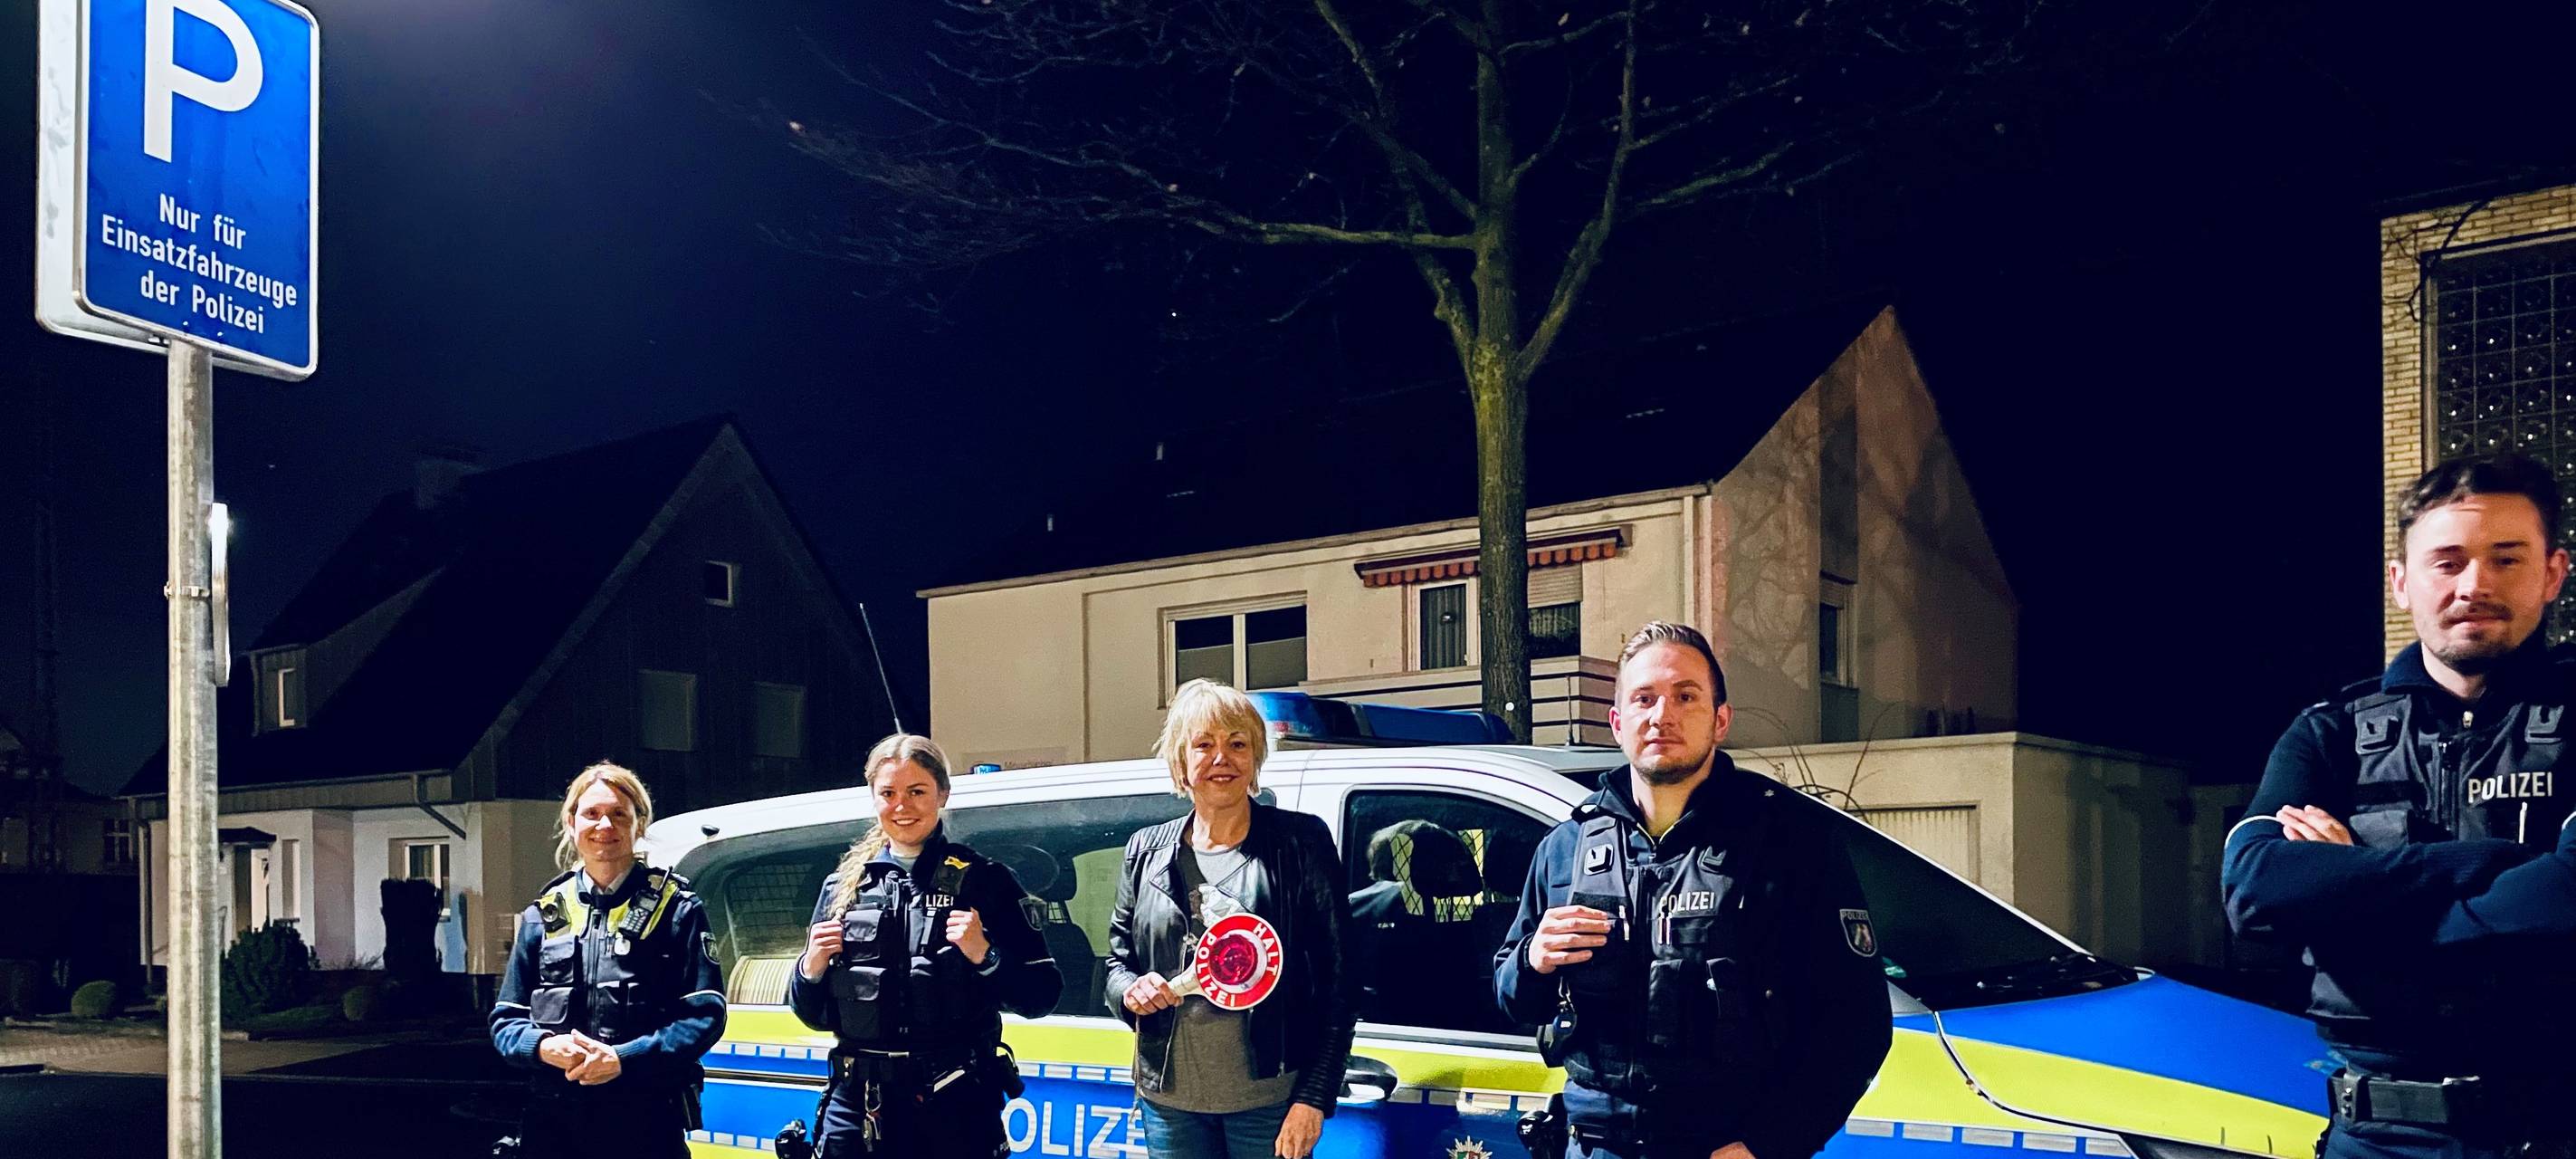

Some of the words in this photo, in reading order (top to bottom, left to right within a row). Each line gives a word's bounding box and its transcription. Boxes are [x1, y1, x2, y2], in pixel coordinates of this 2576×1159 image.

[144, 0, 263, 163] P
[159, 193, 201, 233] Nur
[213, 214, 246, 250] für
[101, 214, 297, 309] Einsatzfahrzeuge
[140, 270, 180, 306] der
[192, 284, 264, 334] Polizei
[2467, 771, 2552, 803] POLIZEI
[925, 894, 954, 907] LIZEI
[1197, 932, 1236, 1007] POLIZEI
[1253, 922, 1279, 976] HALT
[1000, 1097, 1150, 1159] OLIZE
